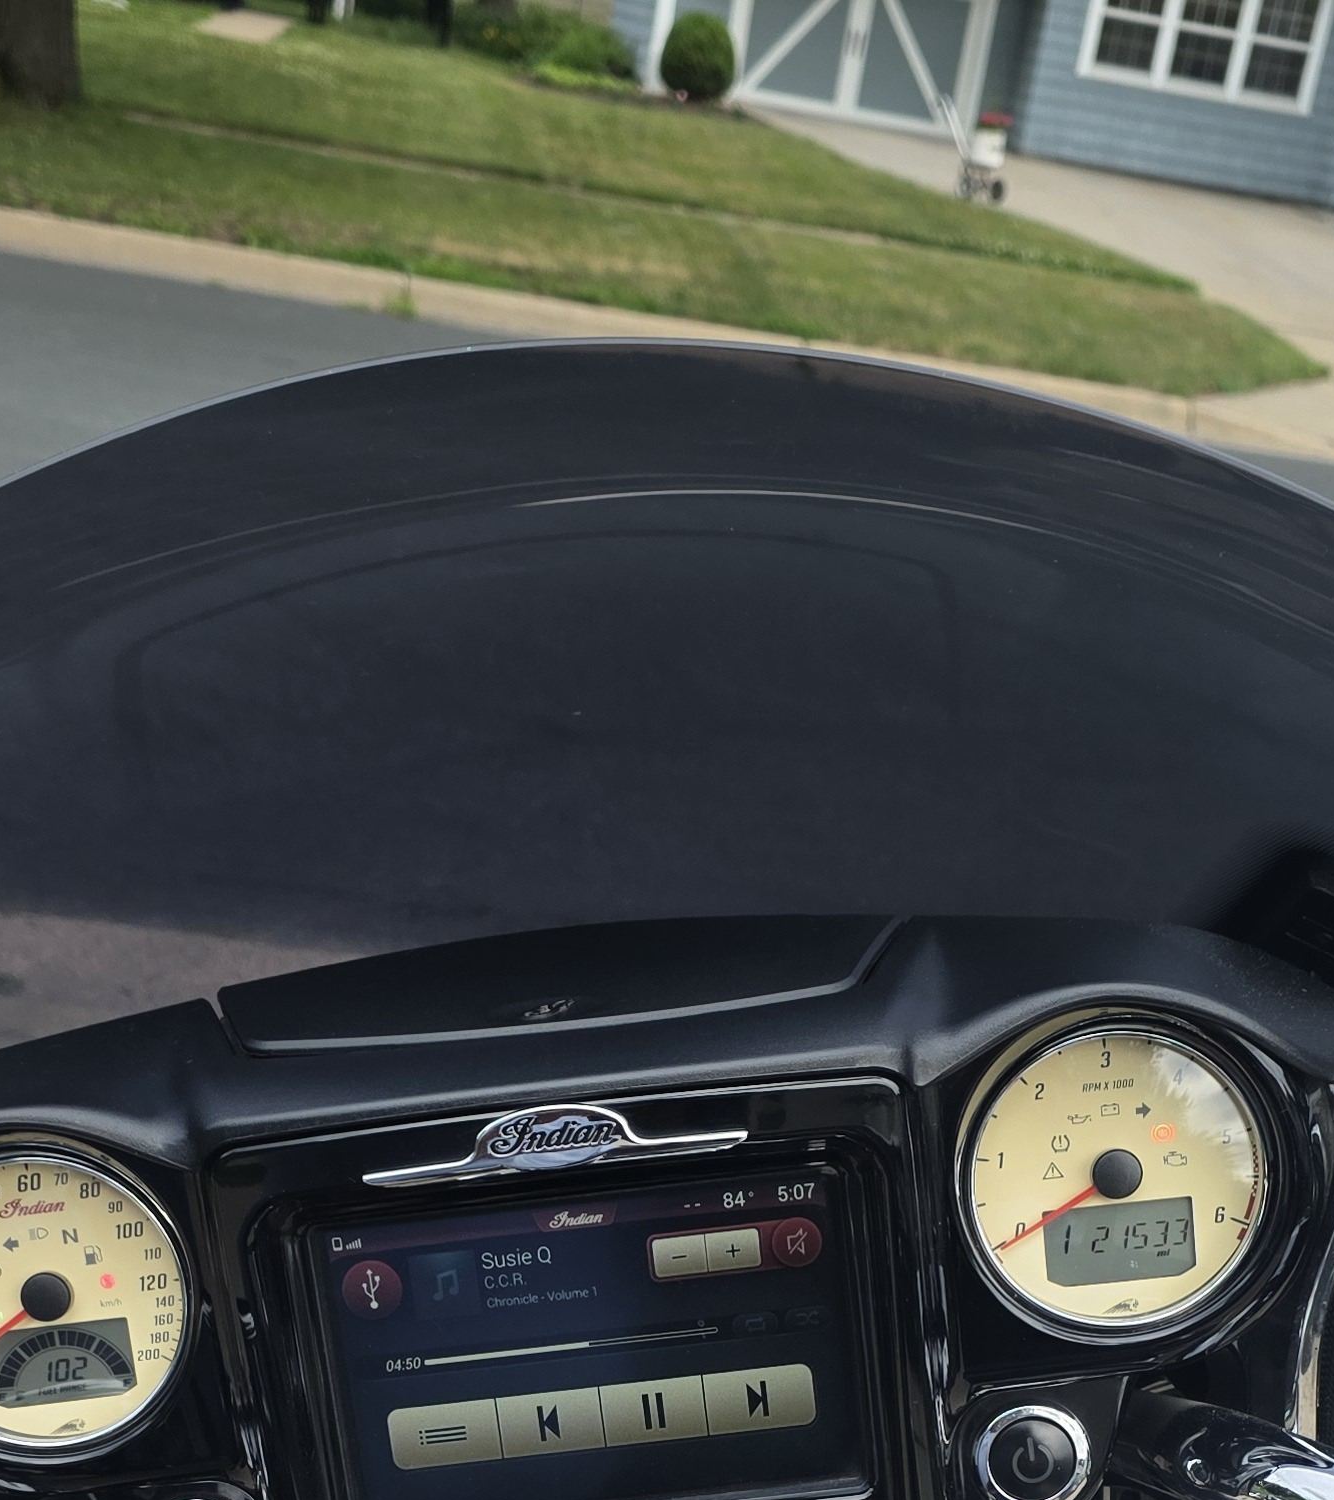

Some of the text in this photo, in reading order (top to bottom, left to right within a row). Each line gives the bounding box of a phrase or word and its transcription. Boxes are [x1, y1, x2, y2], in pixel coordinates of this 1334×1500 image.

[1100, 1051, 1111, 1068] 3
[1173, 1068, 1183, 1085] 4
[1035, 1083, 1045, 1100] 2
[1082, 1081, 1101, 1093] RPM
[1112, 1078, 1134, 1090] 1000
[489, 1115, 619, 1157] Indian
[1222, 1128, 1232, 1144] 5
[997, 1152, 1004, 1169] 1
[17, 1173, 41, 1193] 60
[54, 1172, 69, 1186] 70
[80, 1181, 101, 1199] 80
[778, 1183, 815, 1202] 5:07
[108, 1201, 123, 1213] 90
[1214, 1206, 1225, 1223] 6
[549, 1211, 603, 1229] Indian
[62, 1228, 79, 1244] N
[116, 1221, 144, 1240] 100
[144, 1247, 161, 1261] 110
[481, 1246, 552, 1269] Susie Q
[139, 1273, 167, 1292] 120
[484, 1272, 527, 1289] C.C.R.
[100, 1298, 123, 1308] km/h
[156, 1295, 175, 1308] 140
[487, 1293, 539, 1308] Chronicle
[547, 1287, 589, 1301] Volume
[592, 1286, 598, 1296] 1
[154, 1313, 173, 1326] 160
[150, 1331, 170, 1344] 180
[137, 1348, 160, 1361] 200
[48, 1357, 87, 1382] 102
[386, 1357, 421, 1372] 04:50
